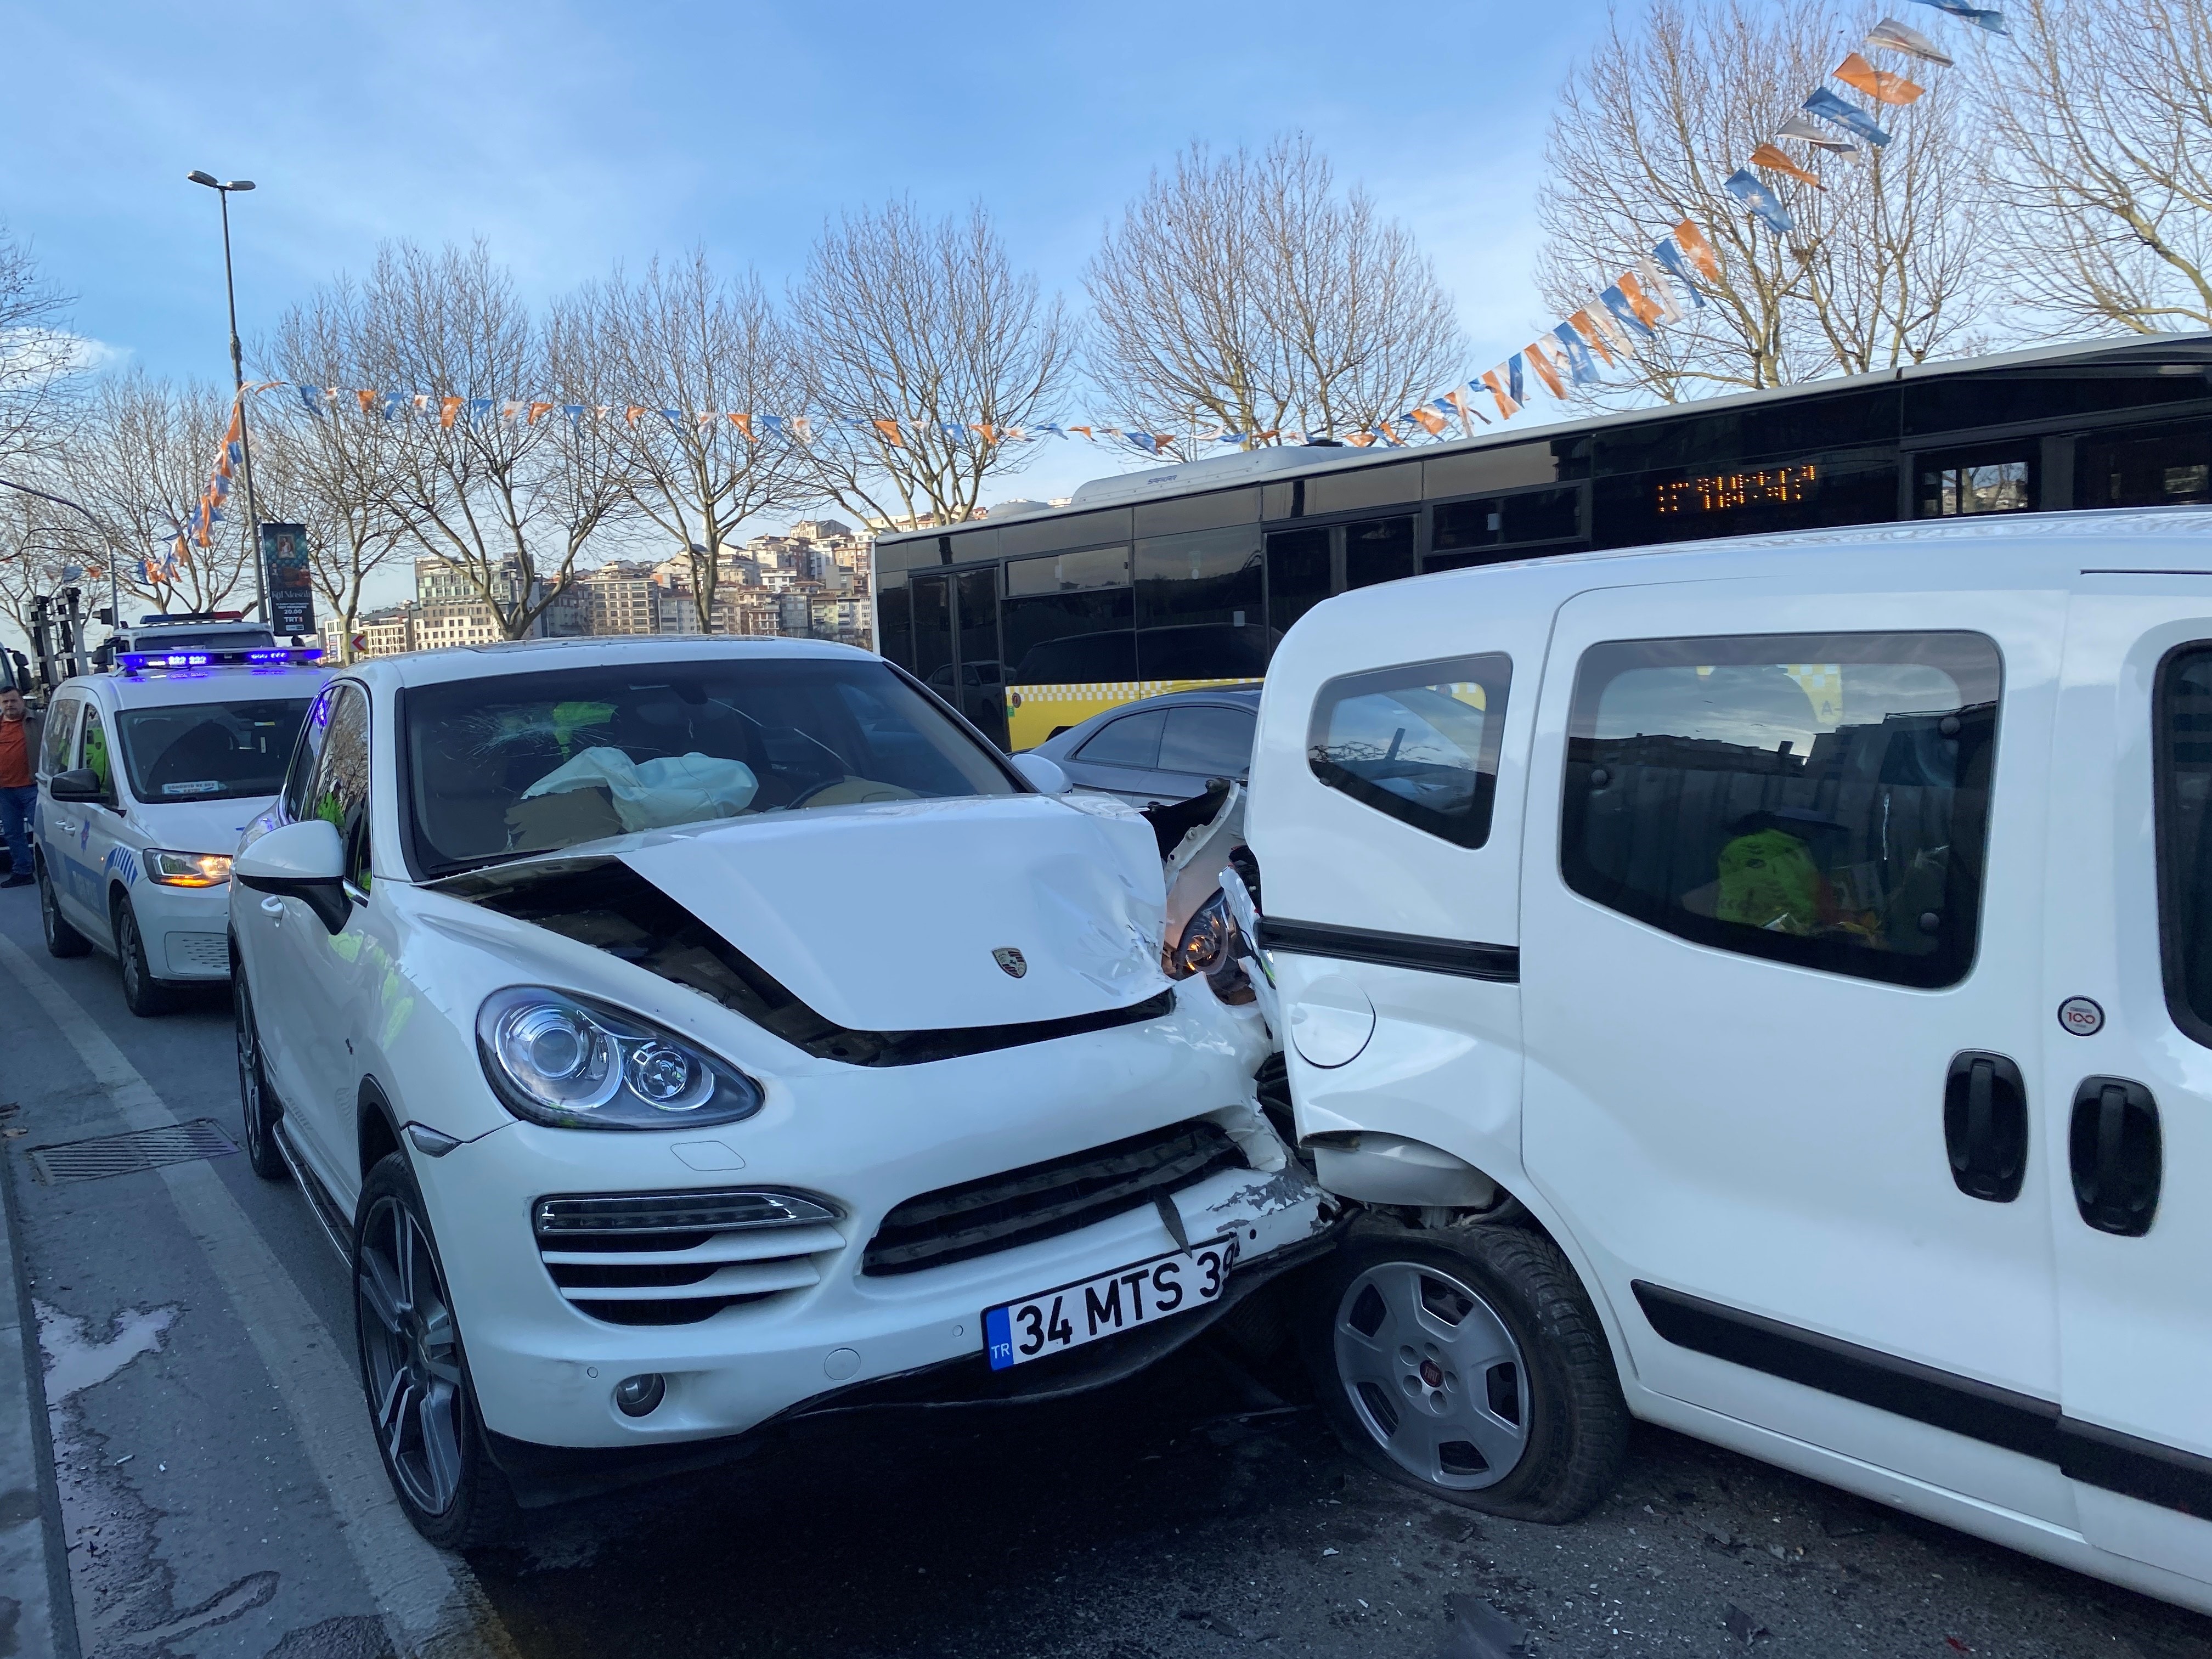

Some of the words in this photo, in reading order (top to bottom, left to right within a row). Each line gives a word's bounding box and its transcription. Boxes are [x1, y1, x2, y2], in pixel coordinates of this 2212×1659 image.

[1016, 1295, 1073, 1355] 34
[1085, 1262, 1183, 1336] MTS
[991, 1342, 1011, 1359] TR
[1424, 1365, 1440, 1383] FIAT
